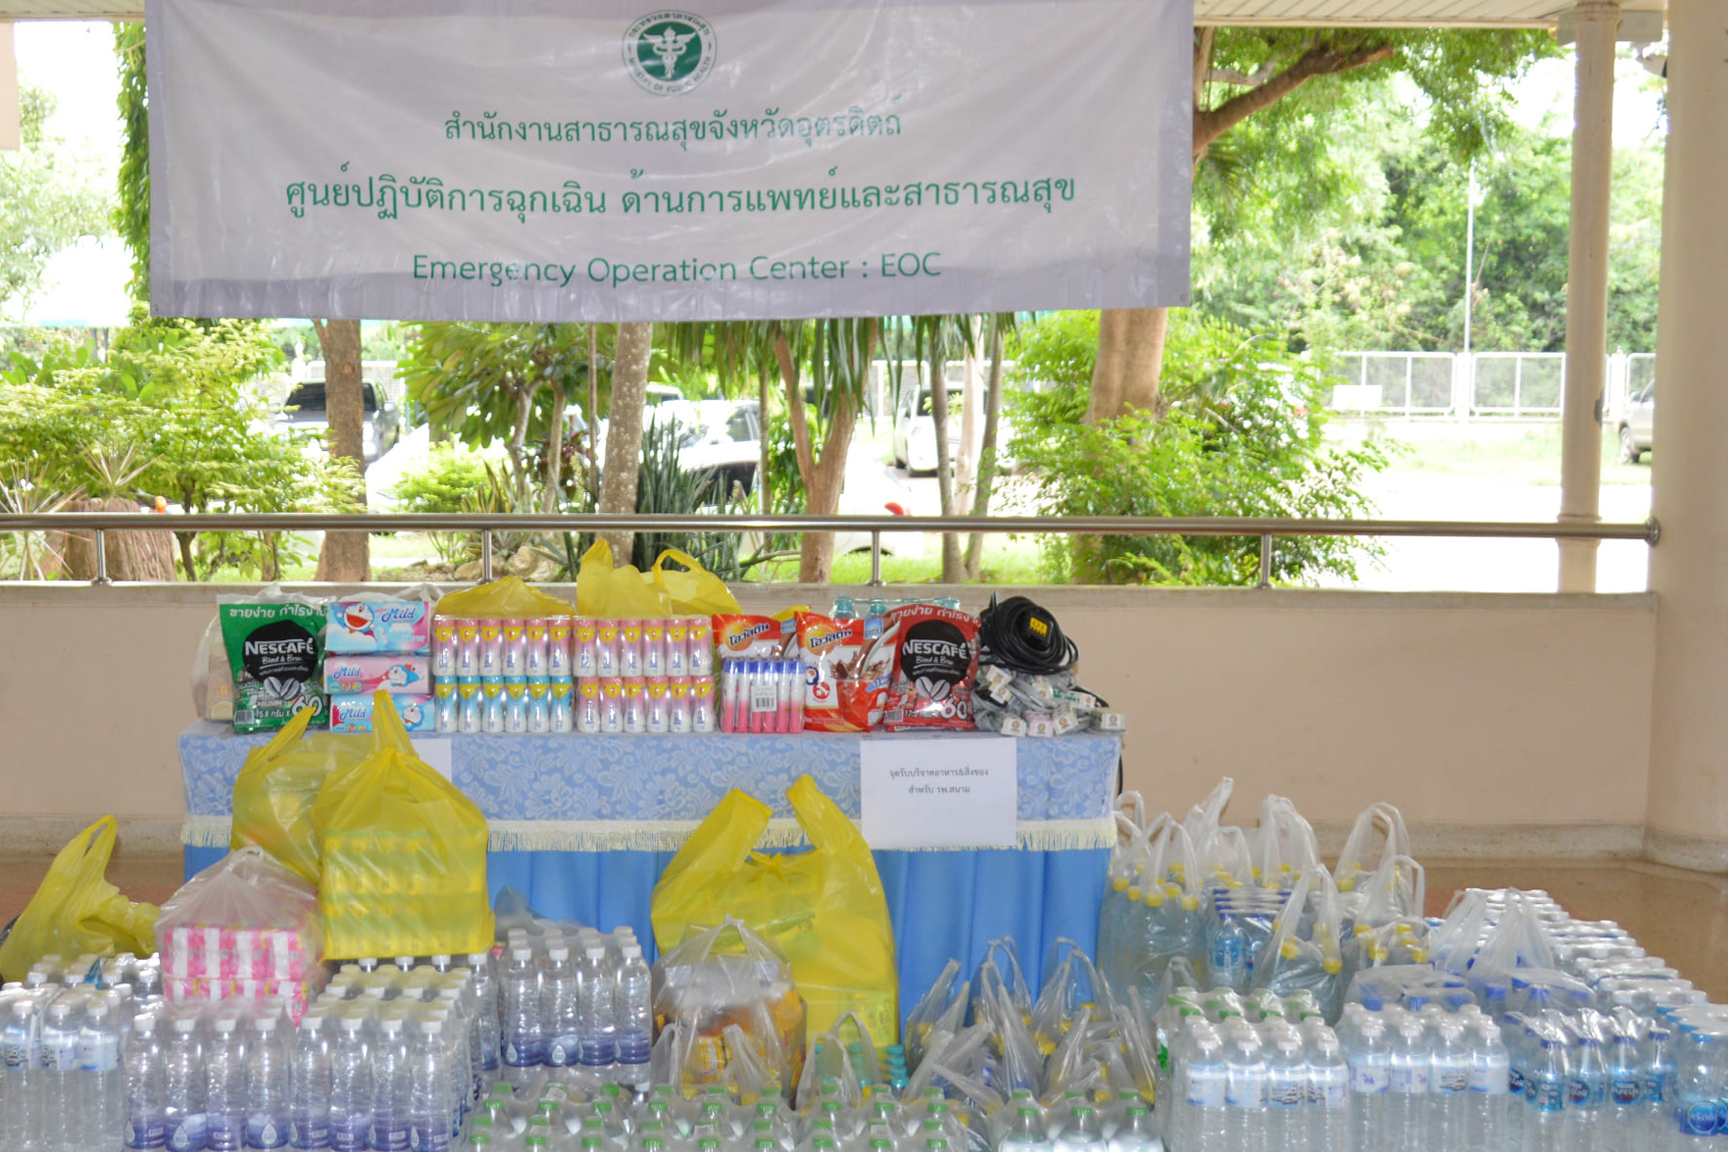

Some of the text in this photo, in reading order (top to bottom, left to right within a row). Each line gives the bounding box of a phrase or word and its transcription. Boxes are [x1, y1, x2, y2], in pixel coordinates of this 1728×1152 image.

[444, 95, 902, 151] สำนักงานสาธารณสุขจังหวัดอุตรดิตถ์
[286, 161, 1076, 224] ศูนย์ปฏิบัติการฉุกเฉิน ด้านการแพทย์และสาธารณสุข
[413, 254, 576, 287] Emergency
[588, 257, 736, 288] Operation
[749, 255, 850, 280] Center
[881, 252, 942, 277] EOC
[229, 606, 276, 618] ขายง่าย
[381, 606, 417, 623] Mild
[728, 622, 770, 646] โอวัลติน
[809, 628, 853, 649] โอวัลติน
[333, 665, 362, 680] Mild
[339, 706, 368, 721] Mild
[940, 699, 968, 720] 60
